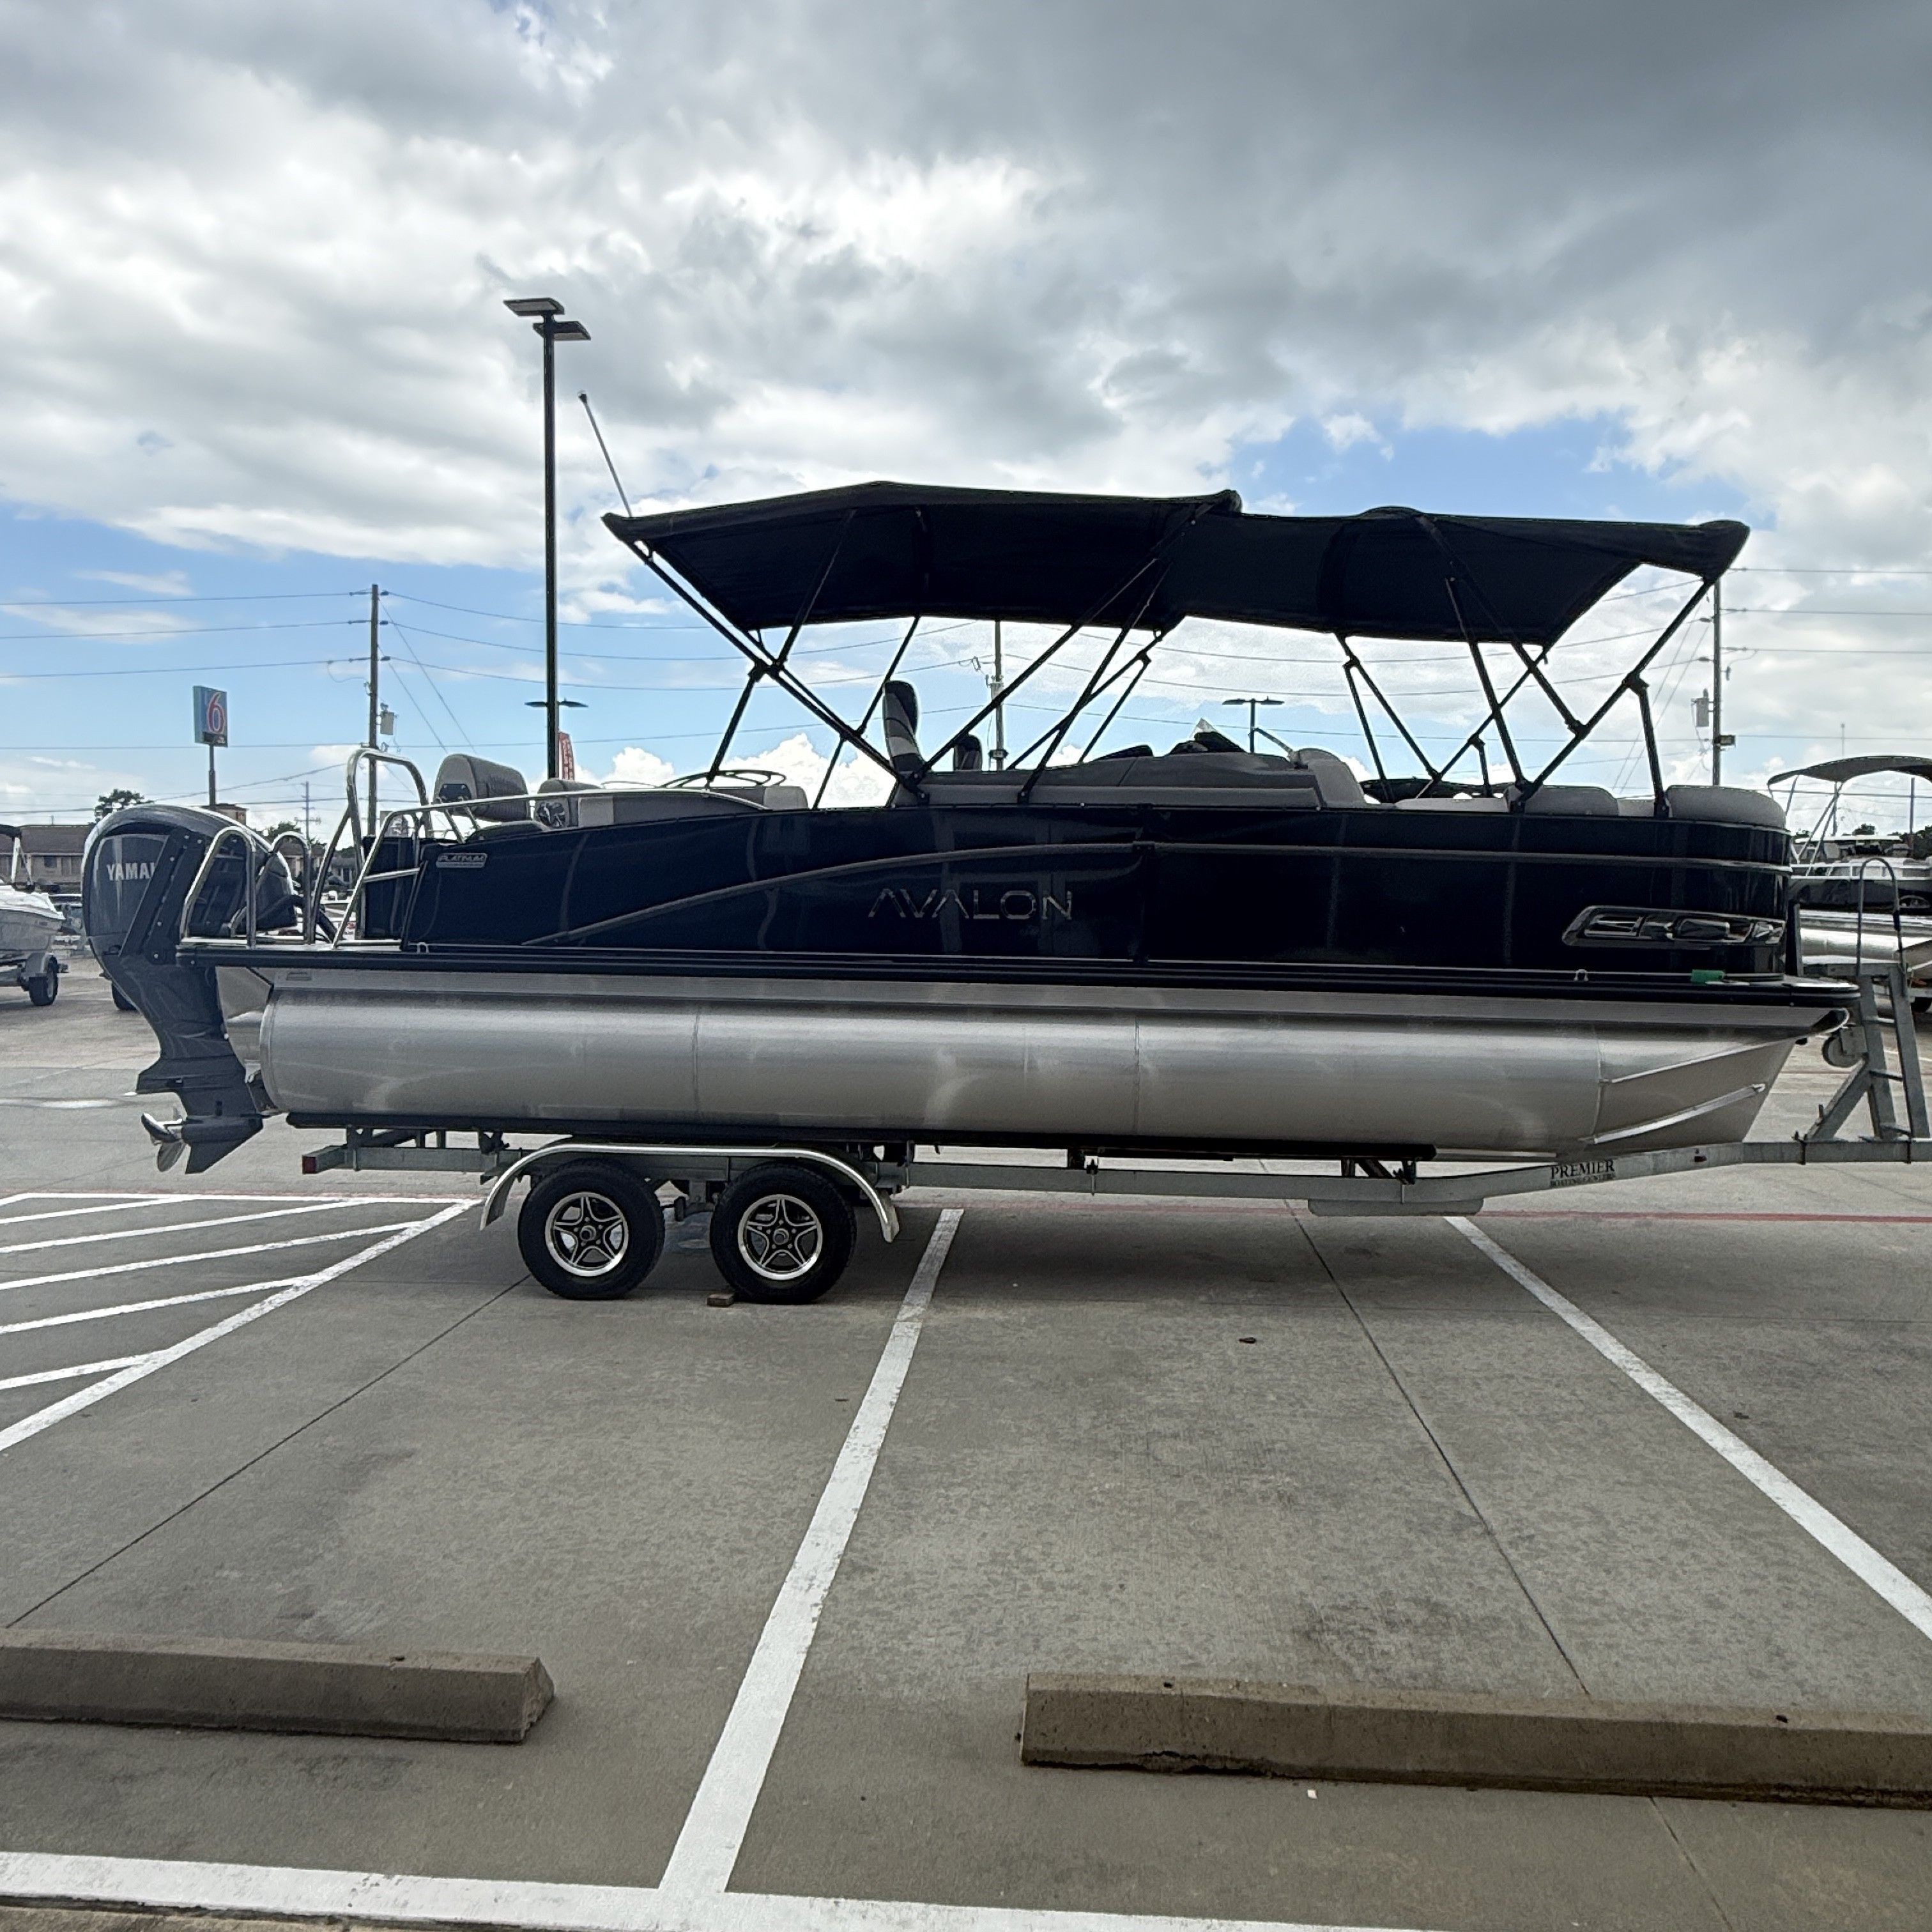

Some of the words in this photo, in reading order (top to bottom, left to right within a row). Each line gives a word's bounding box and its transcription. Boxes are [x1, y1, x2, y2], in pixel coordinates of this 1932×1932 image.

[207, 691, 226, 735] 6
[868, 888, 1071, 920] AVALON
[1551, 1159, 1615, 1179] PREMIER
